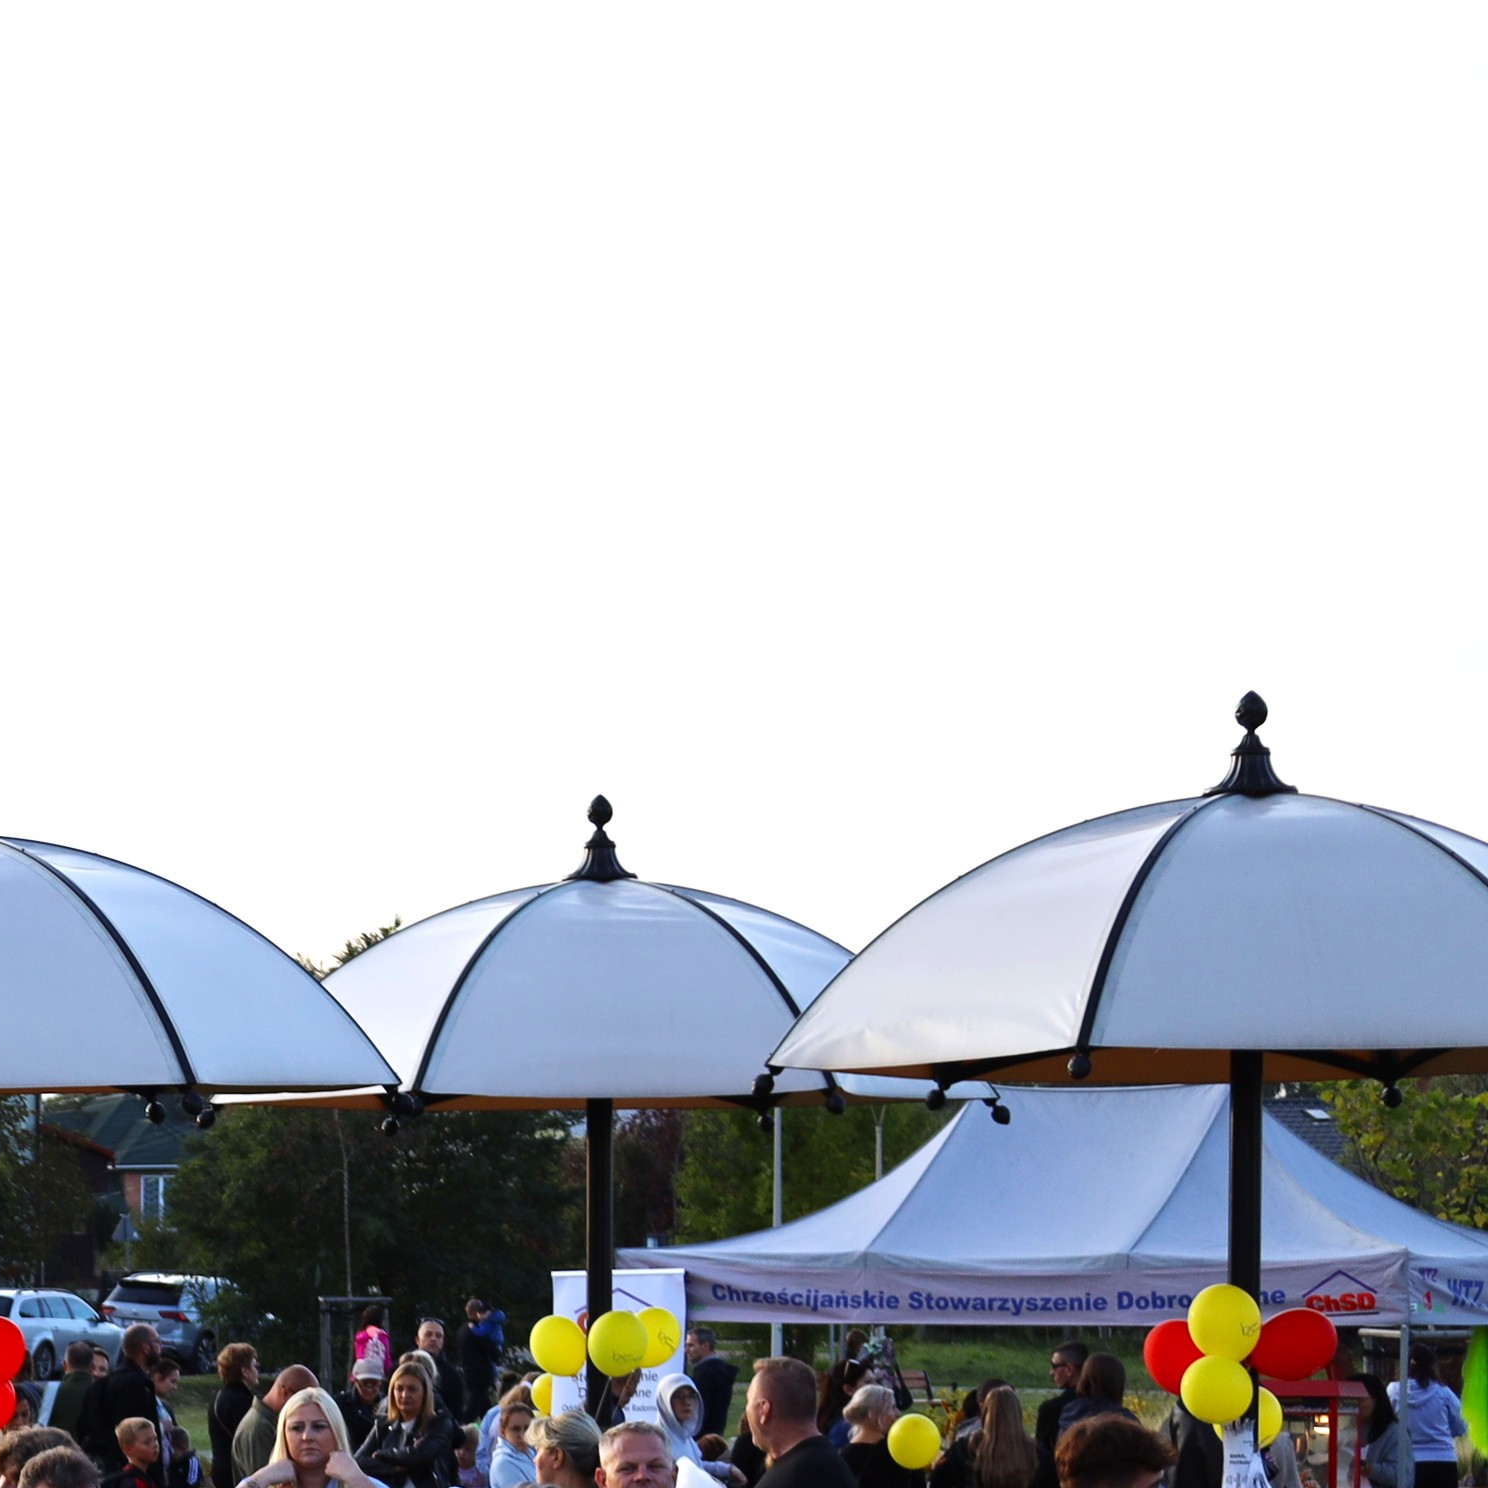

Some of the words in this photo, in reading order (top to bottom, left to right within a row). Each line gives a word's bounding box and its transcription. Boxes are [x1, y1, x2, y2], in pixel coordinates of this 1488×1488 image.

[711, 1283, 900, 1312] Chrześcijańskie
[907, 1290, 1109, 1316] Stowarzyszenie
[1116, 1289, 1286, 1312] Dobrone
[1304, 1293, 1377, 1313] ChSD
